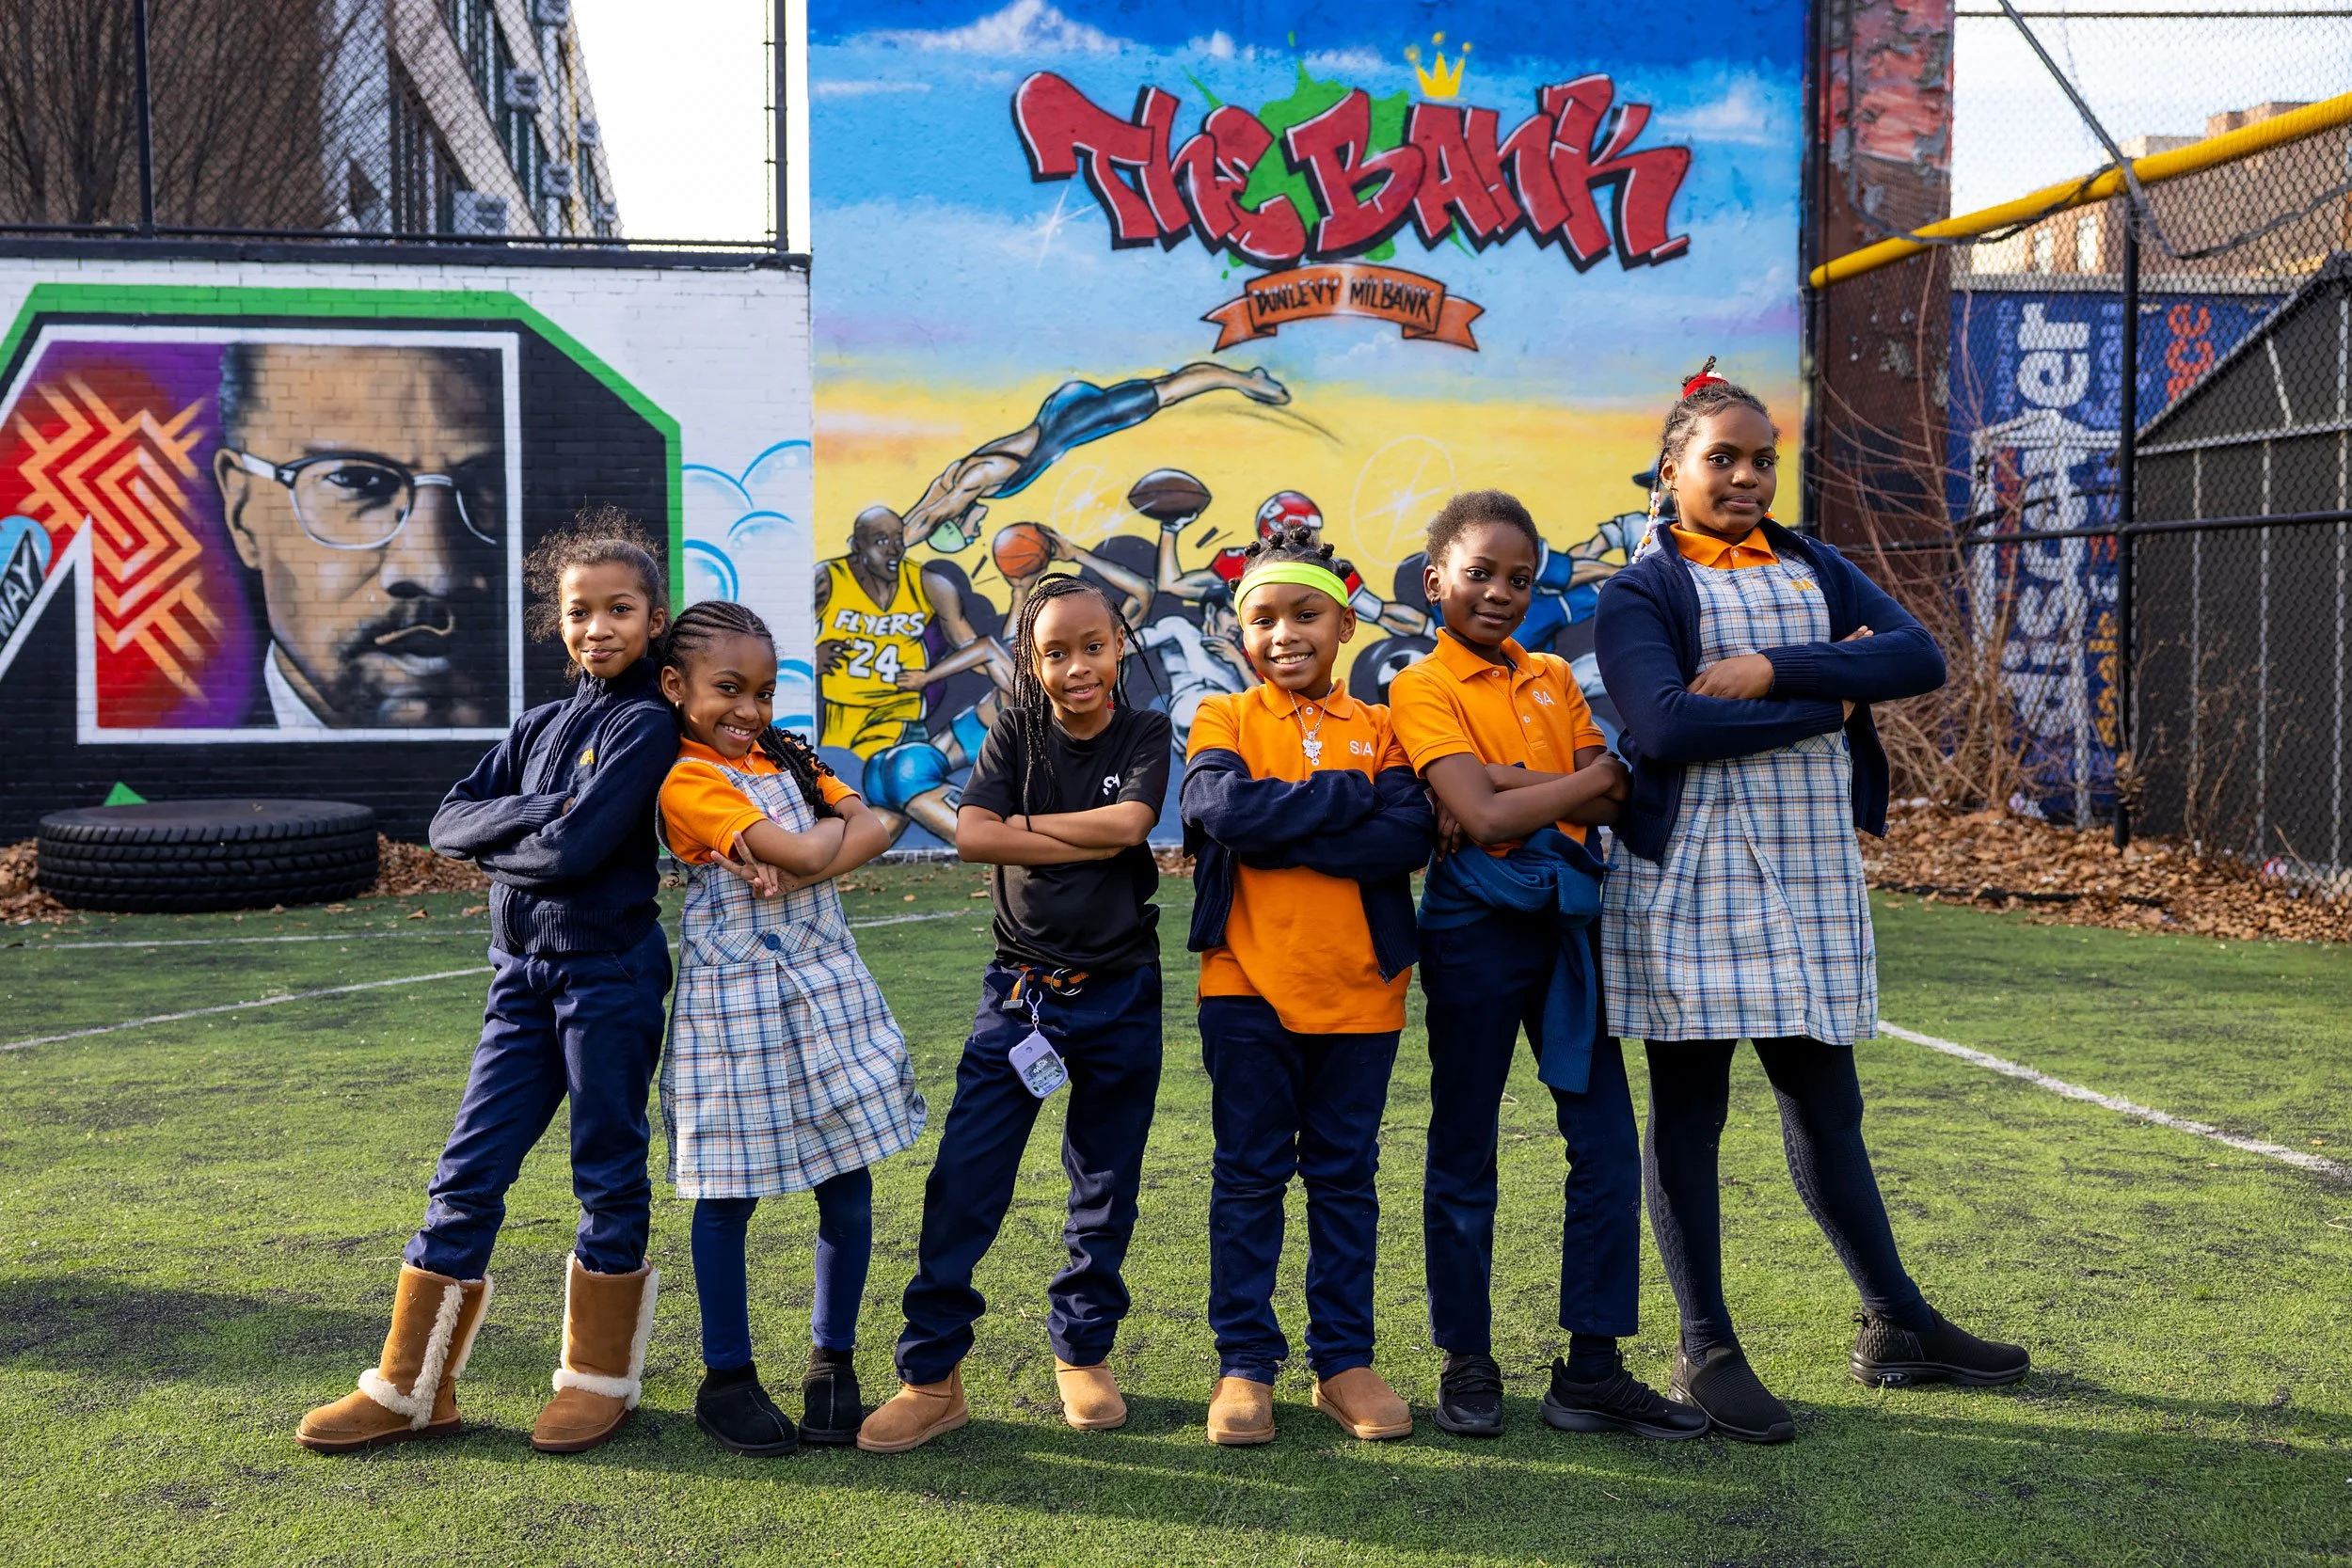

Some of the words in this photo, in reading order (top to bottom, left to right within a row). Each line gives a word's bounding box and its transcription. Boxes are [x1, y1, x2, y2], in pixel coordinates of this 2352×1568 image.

[1252, 278, 1340, 318] DUNLEVY
[834, 610, 926, 637] FLYERS
[848, 638, 901, 683] 24
